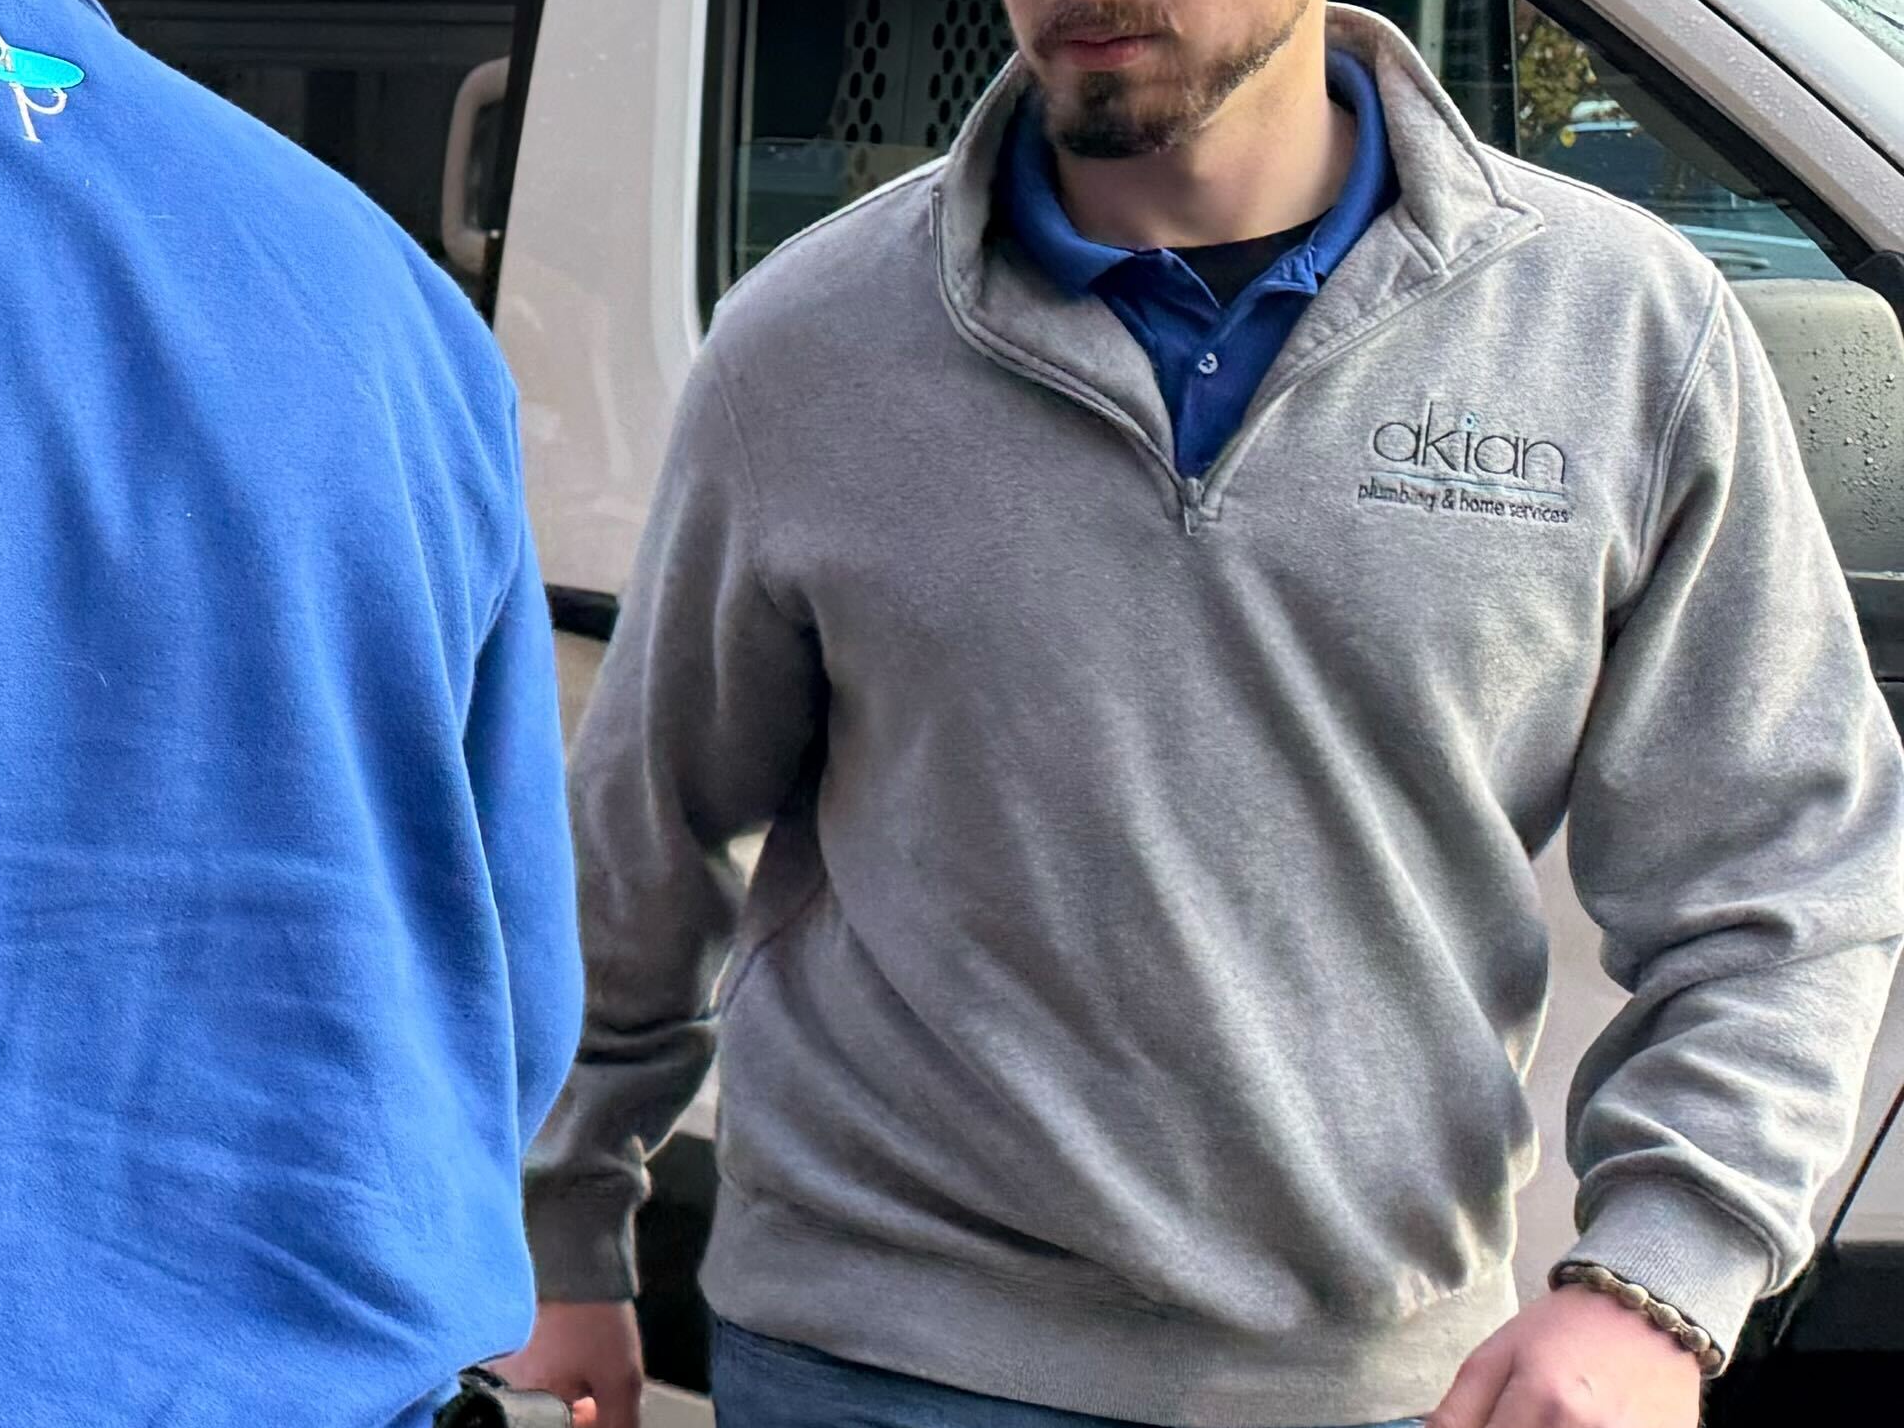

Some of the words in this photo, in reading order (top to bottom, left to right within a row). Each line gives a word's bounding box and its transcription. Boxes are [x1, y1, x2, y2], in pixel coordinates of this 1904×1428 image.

[1373, 400, 1566, 484] akian
[1358, 476, 1436, 512] plumbing
[1442, 488, 1456, 511] &
[1460, 488, 1505, 516] home
[1509, 502, 1570, 523] services
